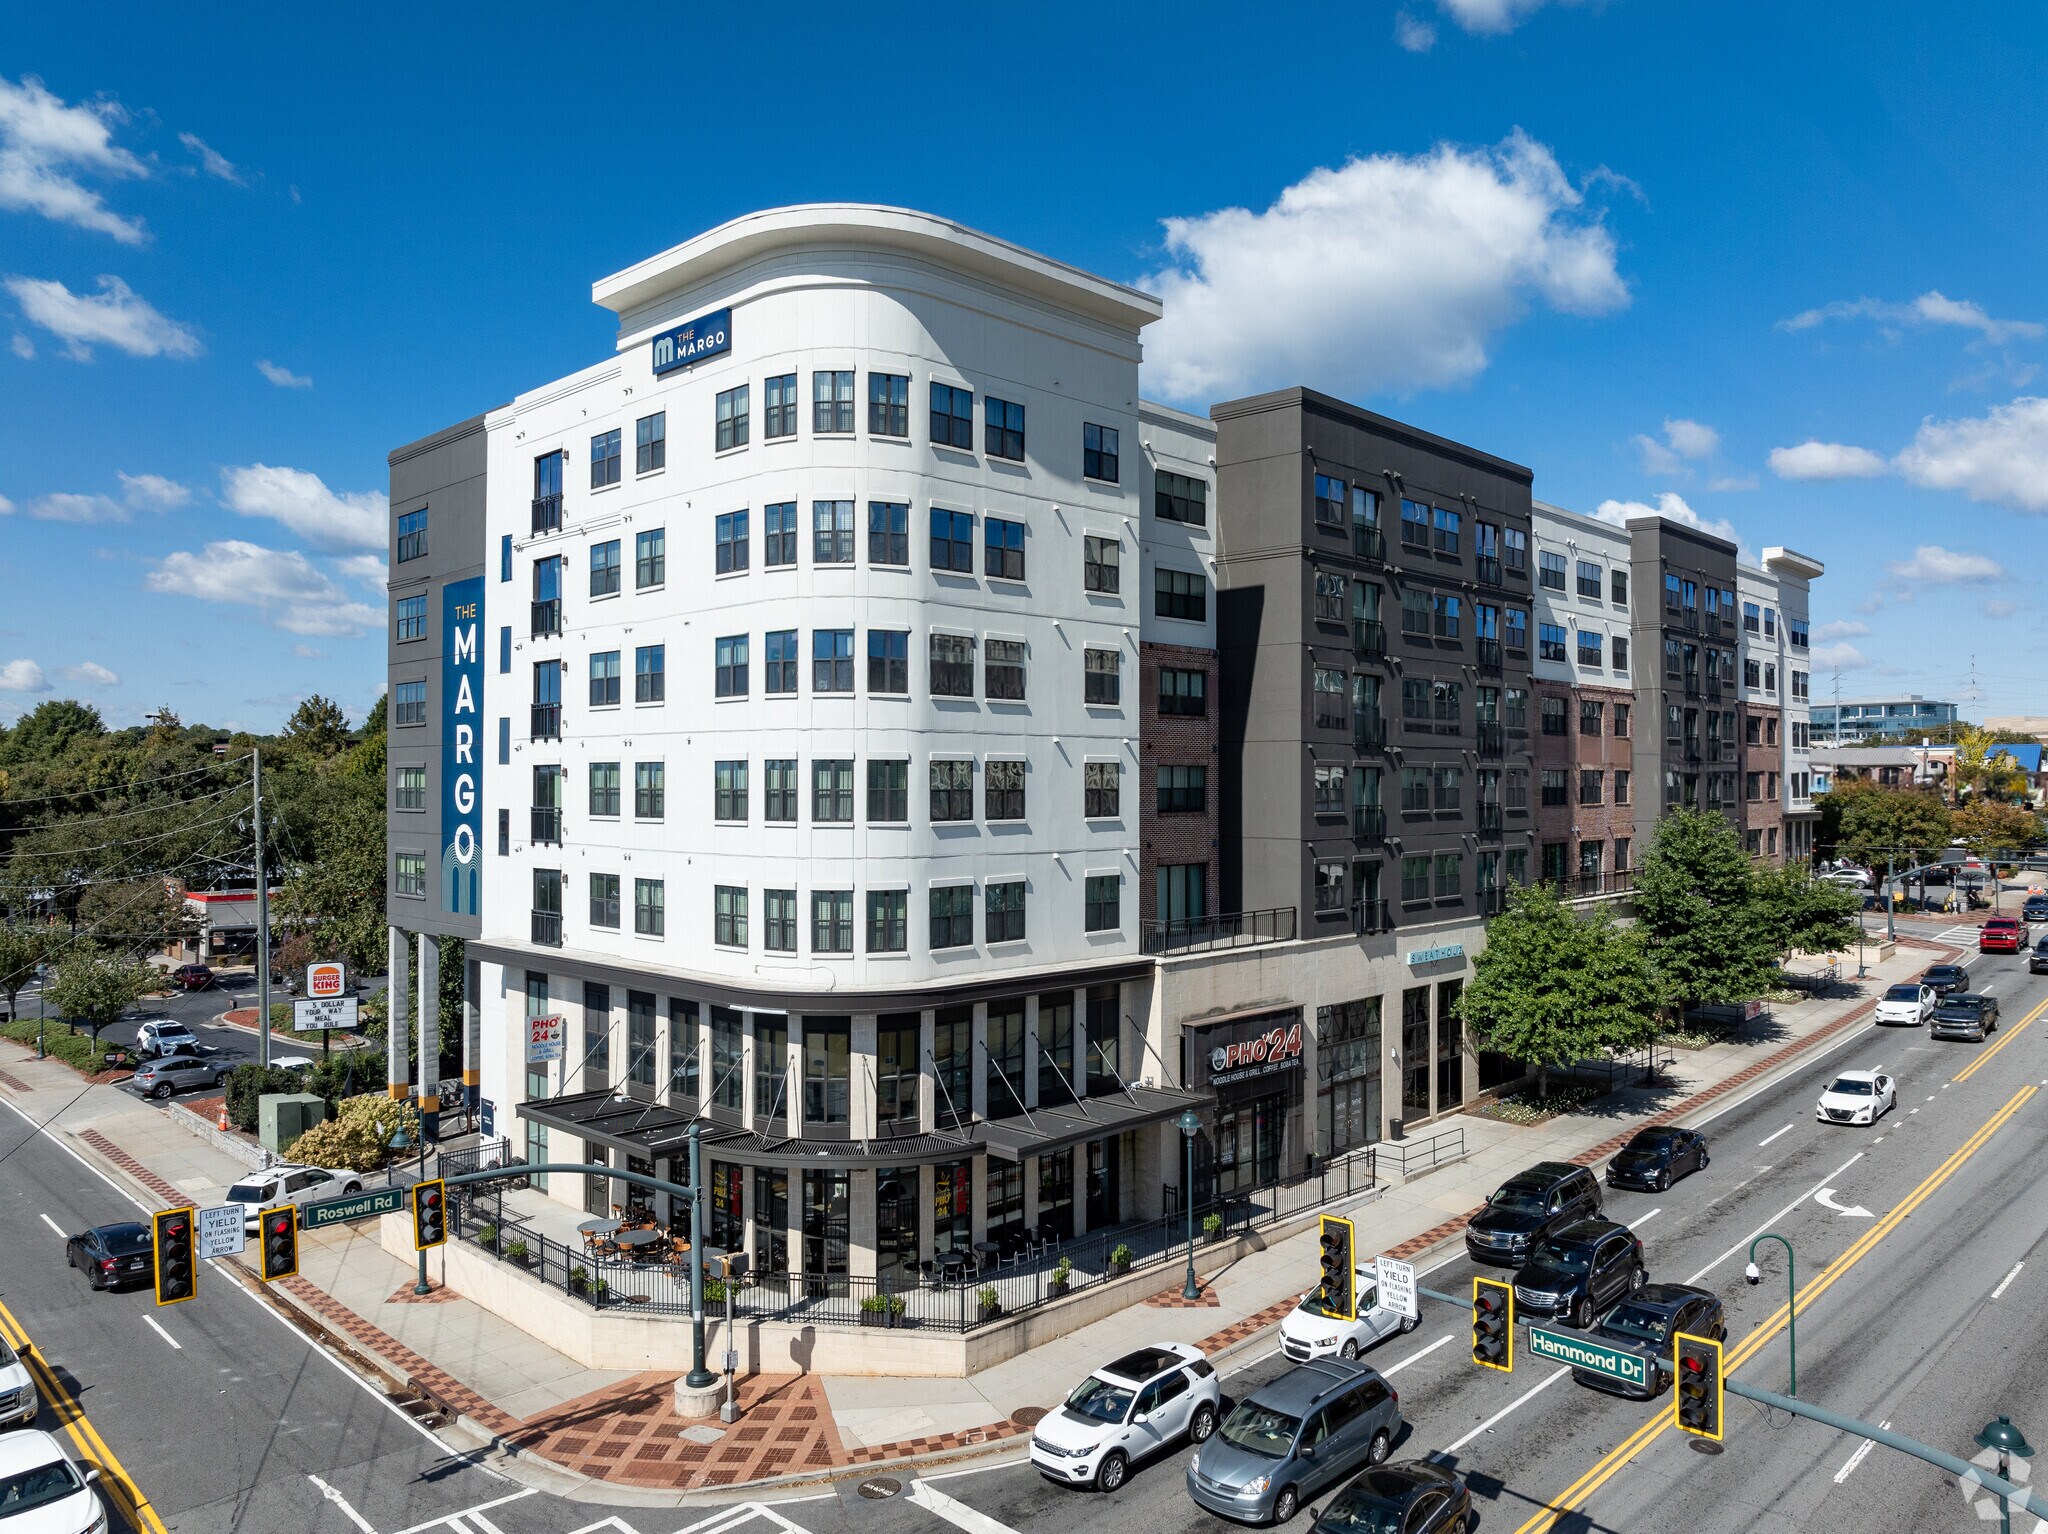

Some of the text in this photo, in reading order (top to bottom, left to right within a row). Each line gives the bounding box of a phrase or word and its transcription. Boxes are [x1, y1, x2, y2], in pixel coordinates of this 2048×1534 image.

[677, 330, 694, 343] THE
[677, 331, 725, 360] MARGO
[454, 603, 477, 620] THE
[454, 623, 476, 865] MARGO
[313, 974, 341, 982] BURGER
[313, 980, 341, 990] KING
[321, 1000, 345, 1008] DOLLAR
[305, 1008, 321, 1016] YOUR
[314, 1014, 332, 1022] MEAL
[323, 1020, 339, 1028] RULE
[531, 1030, 549, 1043] 24
[1268, 1023, 1302, 1063] 24
[1212, 1074, 1231, 1086] NOODLE
[1230, 1070, 1246, 1082] HOUSE
[1280, 1060, 1292, 1070] BOBA
[317, 1195, 393, 1222] Roswell Rd
[715, 1197, 725, 1208] 24
[205, 1207, 240, 1219] LEFT TURN
[208, 1217, 237, 1229] YIELD
[204, 1226, 240, 1239] ON FLASHING
[210, 1236, 235, 1246] YELLOW
[211, 1245, 234, 1255] ARROW
[1380, 1259, 1411, 1273] LEFT TURN
[1383, 1269, 1409, 1284] YIELD
[1381, 1279, 1412, 1295] ON FLASHING
[1386, 1290, 1408, 1303] YELLOW
[1388, 1301, 1407, 1312] ARROW
[1532, 1332, 1642, 1378] Hammond Dr
